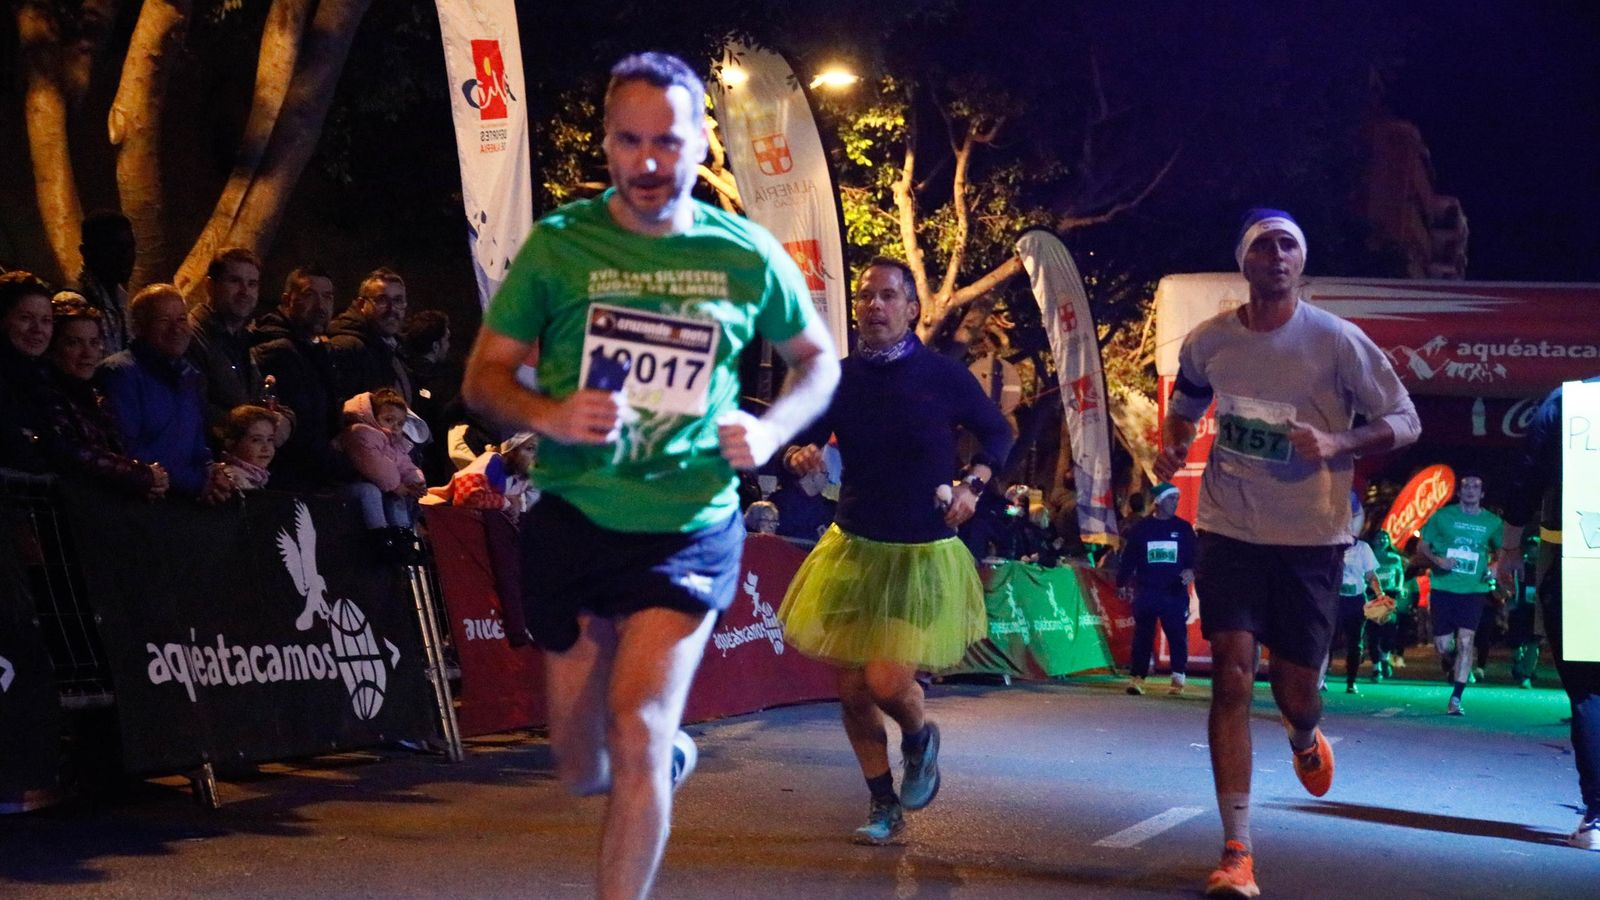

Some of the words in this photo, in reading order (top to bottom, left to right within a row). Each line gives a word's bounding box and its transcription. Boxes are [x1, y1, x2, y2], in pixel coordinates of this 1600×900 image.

[1457, 338, 1600, 361] aquéataca
[1223, 422, 1288, 453] 1757
[1569, 415, 1600, 451] PL
